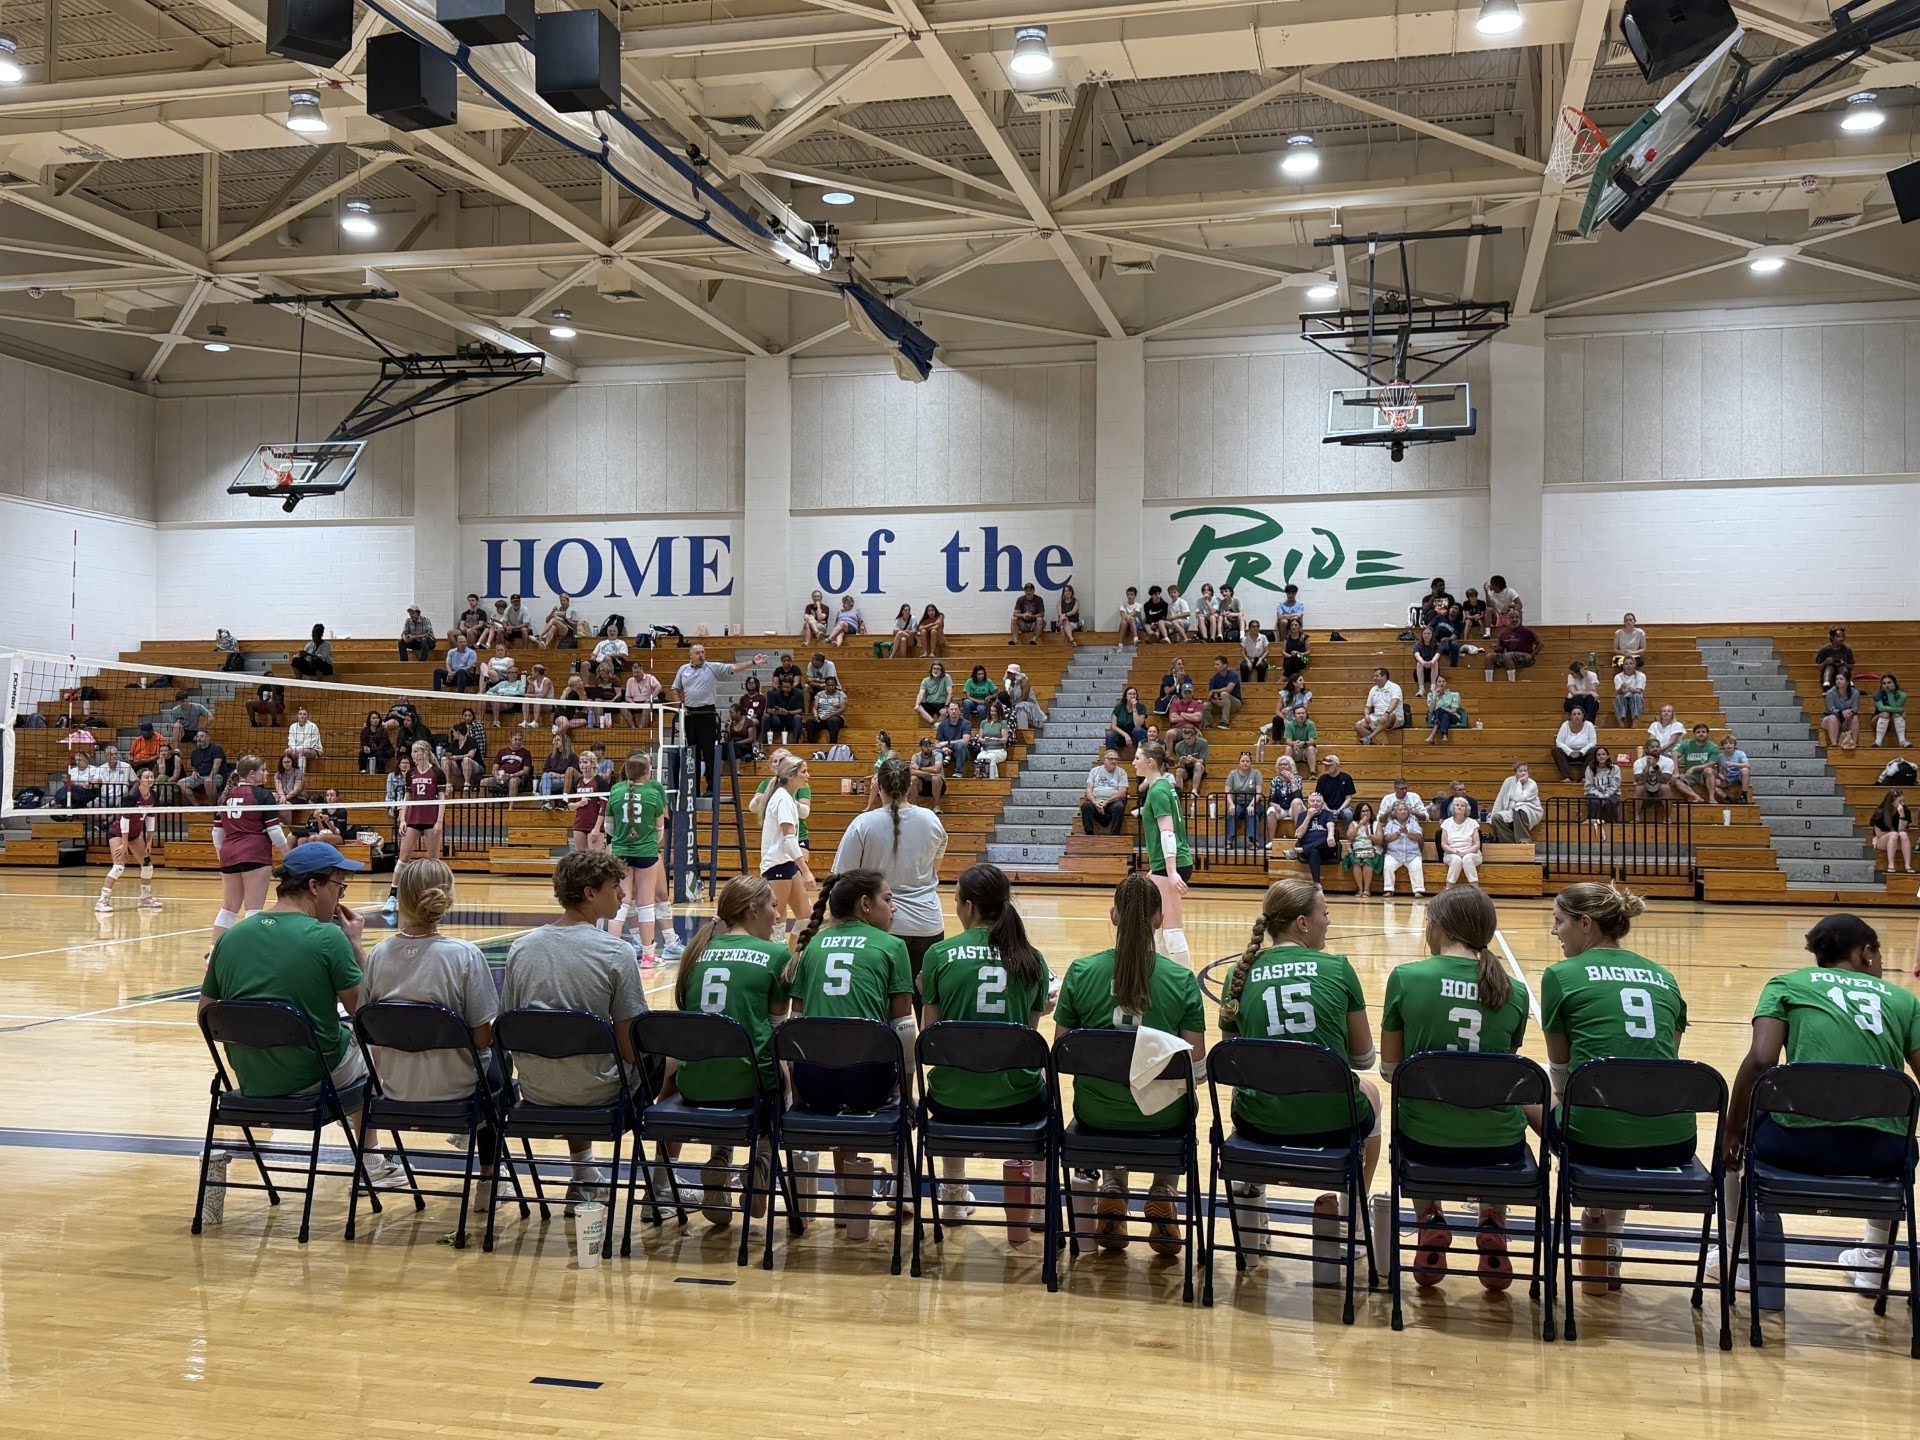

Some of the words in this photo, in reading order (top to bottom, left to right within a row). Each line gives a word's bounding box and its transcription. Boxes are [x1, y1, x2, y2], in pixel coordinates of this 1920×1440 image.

[481, 534, 734, 599] HOME
[817, 528, 895, 595] of
[941, 526, 1074, 594] the
[1170, 506, 1431, 597] PRIDE
[1752, 693, 1757, 701] K
[1759, 709, 1764, 717] J
[1773, 743, 1779, 751] H
[1060, 757, 1066, 765] G
[1780, 761, 1787, 769] G
[1053, 774, 1057, 782] F
[1788, 780, 1794, 788] F
[416, 784, 426, 795] 12
[1797, 800, 1802, 809] E
[1039, 810, 1044, 818] D
[687, 778, 695, 865] PRIDE
[1805, 821, 1811, 830] D
[1031, 829, 1036, 837] C
[1023, 848, 1028, 857] B
[1814, 841, 1820, 851] C
[1823, 865, 1830, 875] B
[820, 935, 867, 950] ORTIZ
[696, 948, 771, 968] AUFFENEKER
[823, 953, 855, 996] 5
[1251, 961, 1319, 983] GASPER
[1584, 965, 1669, 990] BAGNELL
[700, 967, 731, 1013] 6
[976, 965, 1008, 1014] 2
[1440, 978, 1481, 1001] HOO
[1810, 972, 1892, 996] POWELL
[1261, 982, 1317, 1036] 15
[1620, 988, 1656, 1039] 9
[1827, 986, 1884, 1036] 13
[1447, 1006, 1483, 1053] 3
